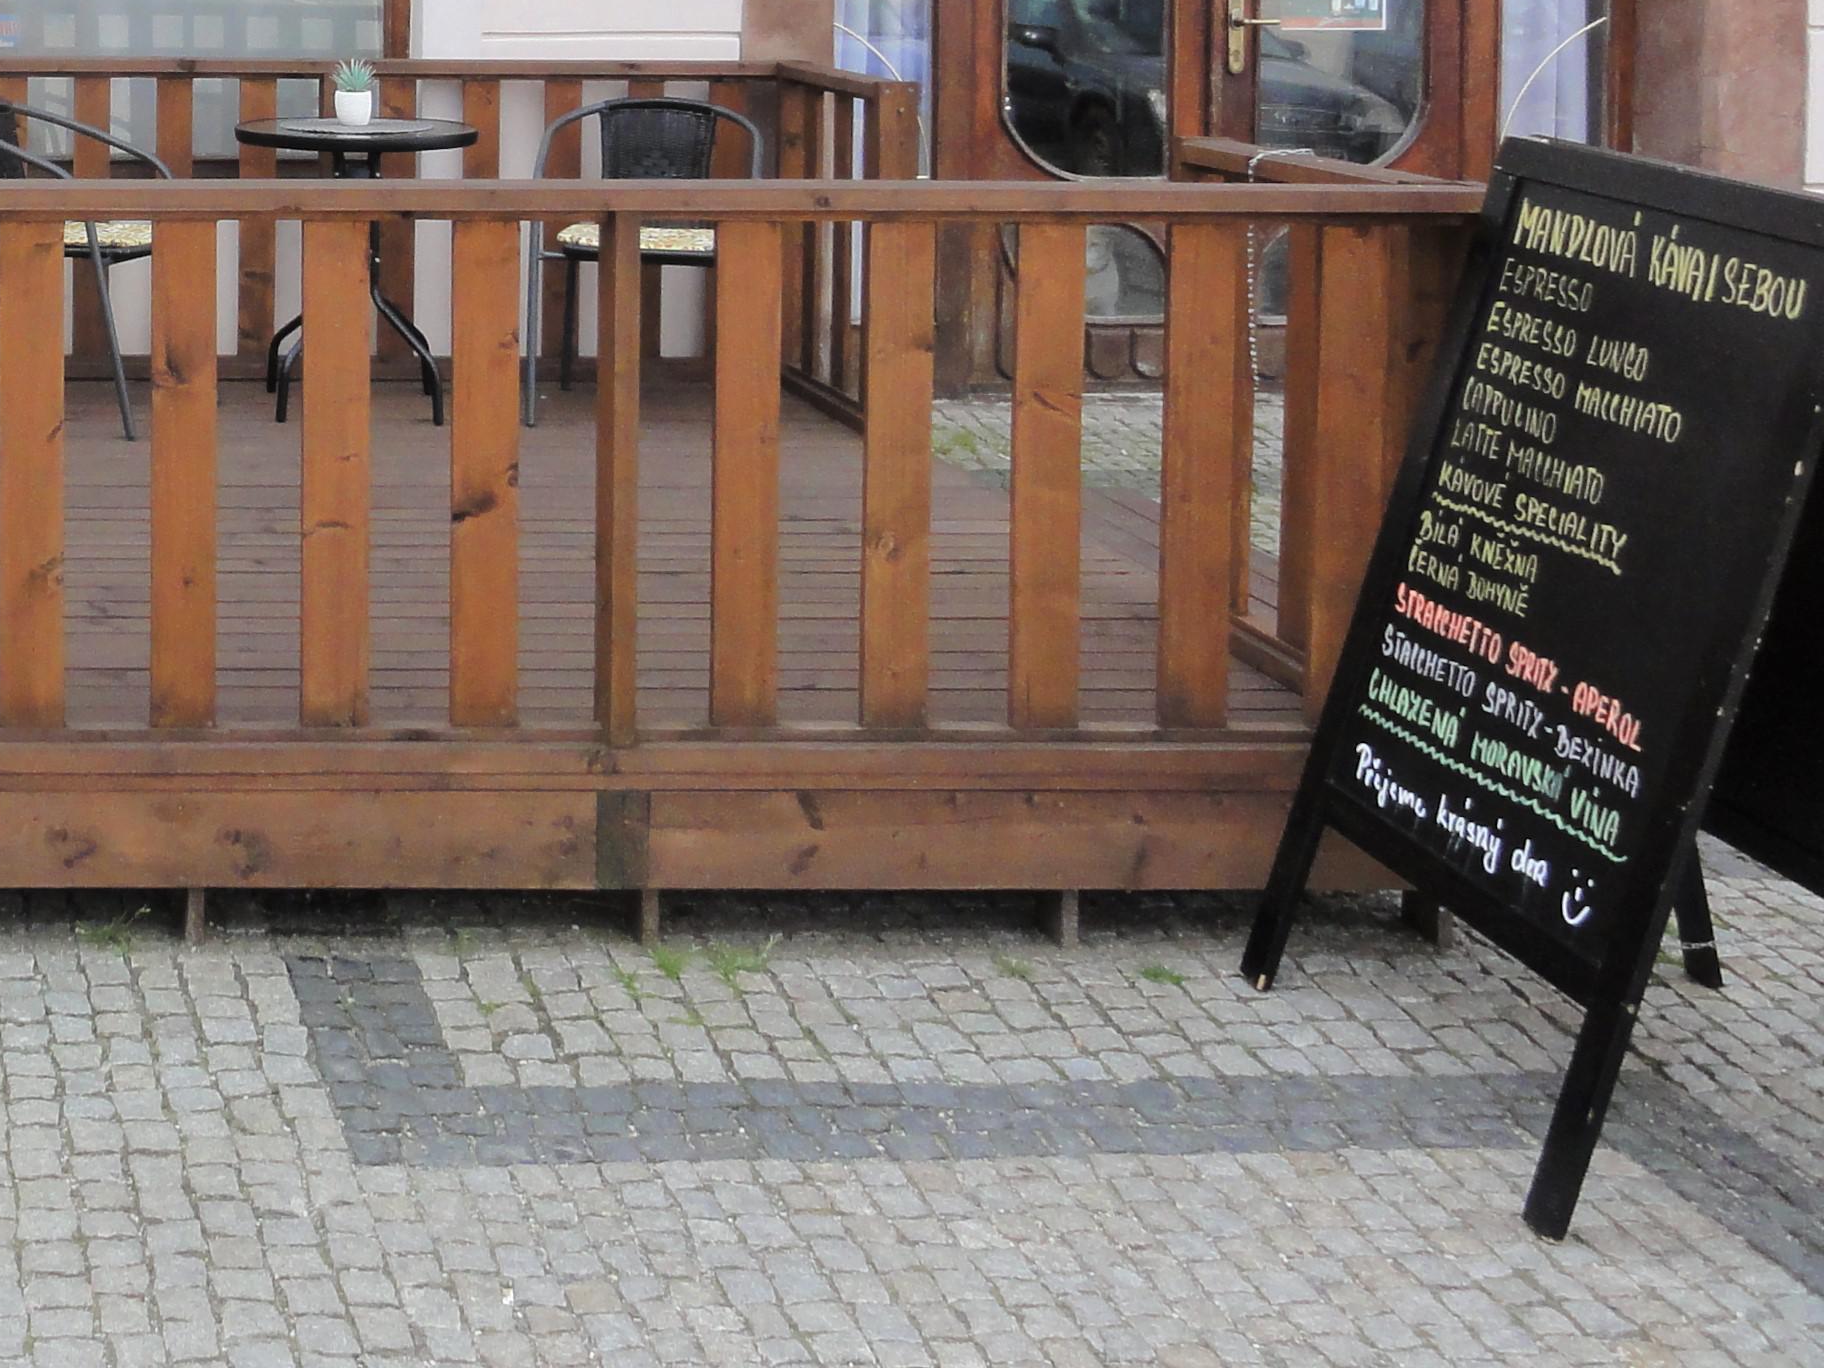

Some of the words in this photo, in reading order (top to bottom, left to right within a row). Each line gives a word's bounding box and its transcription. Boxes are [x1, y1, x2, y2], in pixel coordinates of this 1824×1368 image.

[1498, 258, 1594, 313] ESPRESSO
[1512, 197, 1643, 279] MANDLOVÁ
[1648, 224, 1706, 302] KÁVA
[1721, 256, 1808, 321] SEBOU
[1487, 300, 1577, 358] ESPRESSO
[1586, 335, 1649, 382] LUNGO
[1462, 375, 1557, 445] CAPPUCINO
[1476, 342, 1566, 400] ESPRESSO
[1574, 382, 1683, 444] MACCHIATO
[1450, 417, 1504, 460] LATTE
[1505, 439, 1605, 505] MACCHIATO
[1419, 508, 1464, 548] BÍLÁ
[1469, 532, 1538, 584] KNĚŽNA
[1438, 455, 1507, 509] KÁVOVÉ
[1513, 492, 1628, 559] SPECIALITY
[1407, 537, 1464, 592] ČERNÁ
[1465, 570, 1529, 618] BOHYNĚ
[1367, 666, 1467, 749] CHLAZENÁ
[1570, 786, 1622, 847] VÍNA
[1572, 681, 1642, 753] APEROL
[1355, 742, 1428, 819] Přejeme
[1435, 790, 1504, 875] krásný
